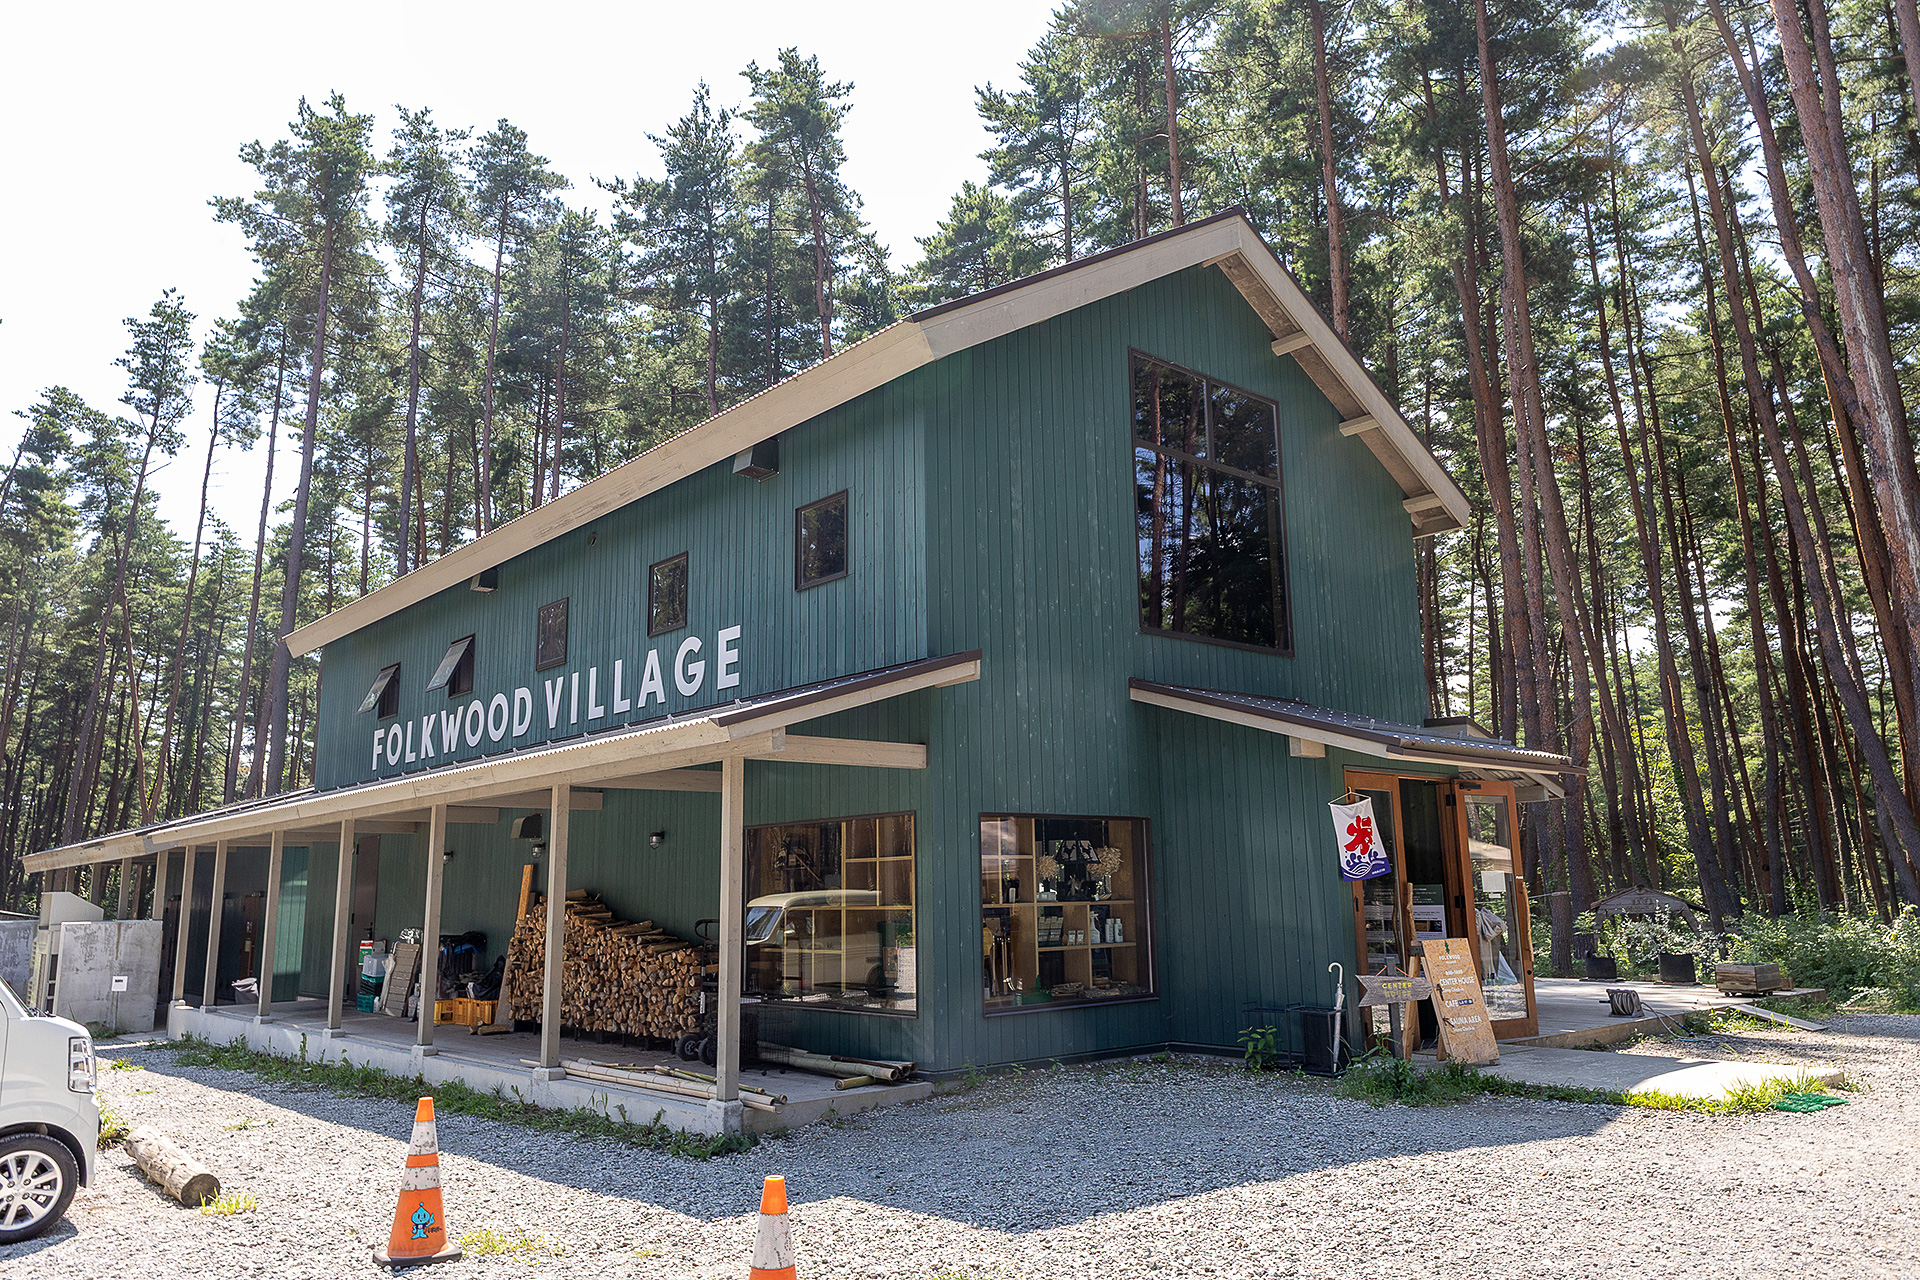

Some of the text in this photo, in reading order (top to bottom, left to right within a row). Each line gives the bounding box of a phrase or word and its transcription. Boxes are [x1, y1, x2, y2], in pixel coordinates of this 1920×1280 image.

[371, 624, 741, 770] FOLKWOOD VILLAGE
[1381, 981, 1412, 989] CENTER
[1439, 976, 1475, 986] CENTER HOUSE
[1384, 989, 1412, 998] HOUSE
[1445, 999, 1459, 1008] CAFE
[1450, 1015, 1482, 1025] SAUNA AREA
